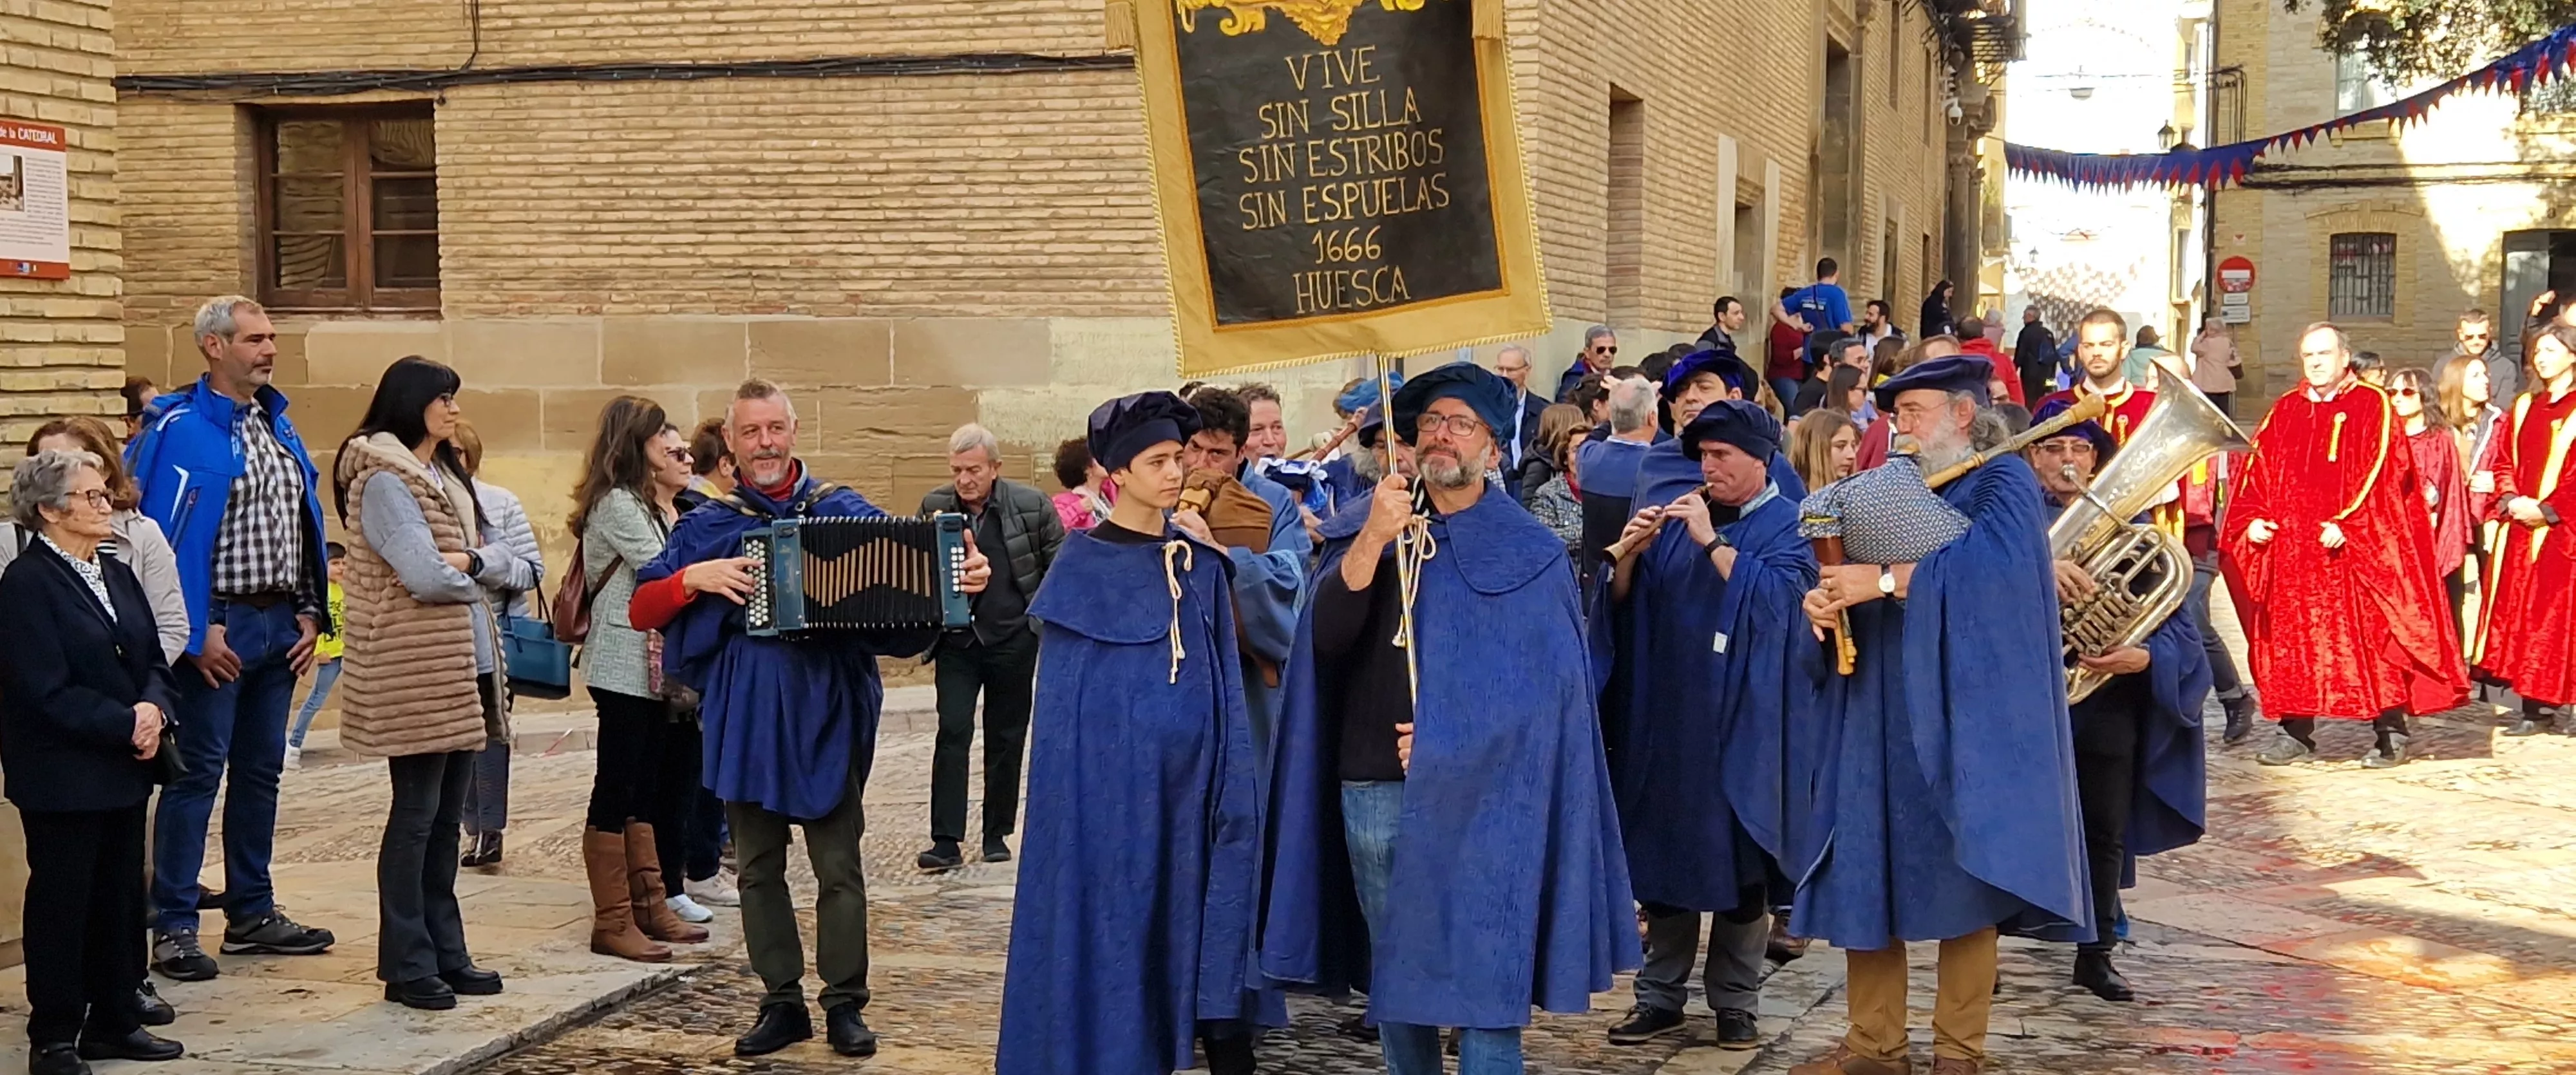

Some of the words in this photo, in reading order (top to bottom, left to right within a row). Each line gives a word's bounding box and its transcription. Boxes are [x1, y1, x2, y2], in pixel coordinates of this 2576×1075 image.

[1283, 44, 1381, 91] VIVE
[17, 127, 58, 145] CATEDRAL
[1258, 98, 1310, 140] SIN
[1330, 86, 1423, 131] SILLA
[1238, 142, 1297, 183] SIN
[1307, 127, 1444, 177] ESTRIBOS
[1238, 189, 1287, 230] SIN
[1302, 172, 1450, 224] ESPUELAS
[1311, 225, 1381, 265] 1666
[1292, 264, 1412, 314] HUESCA
